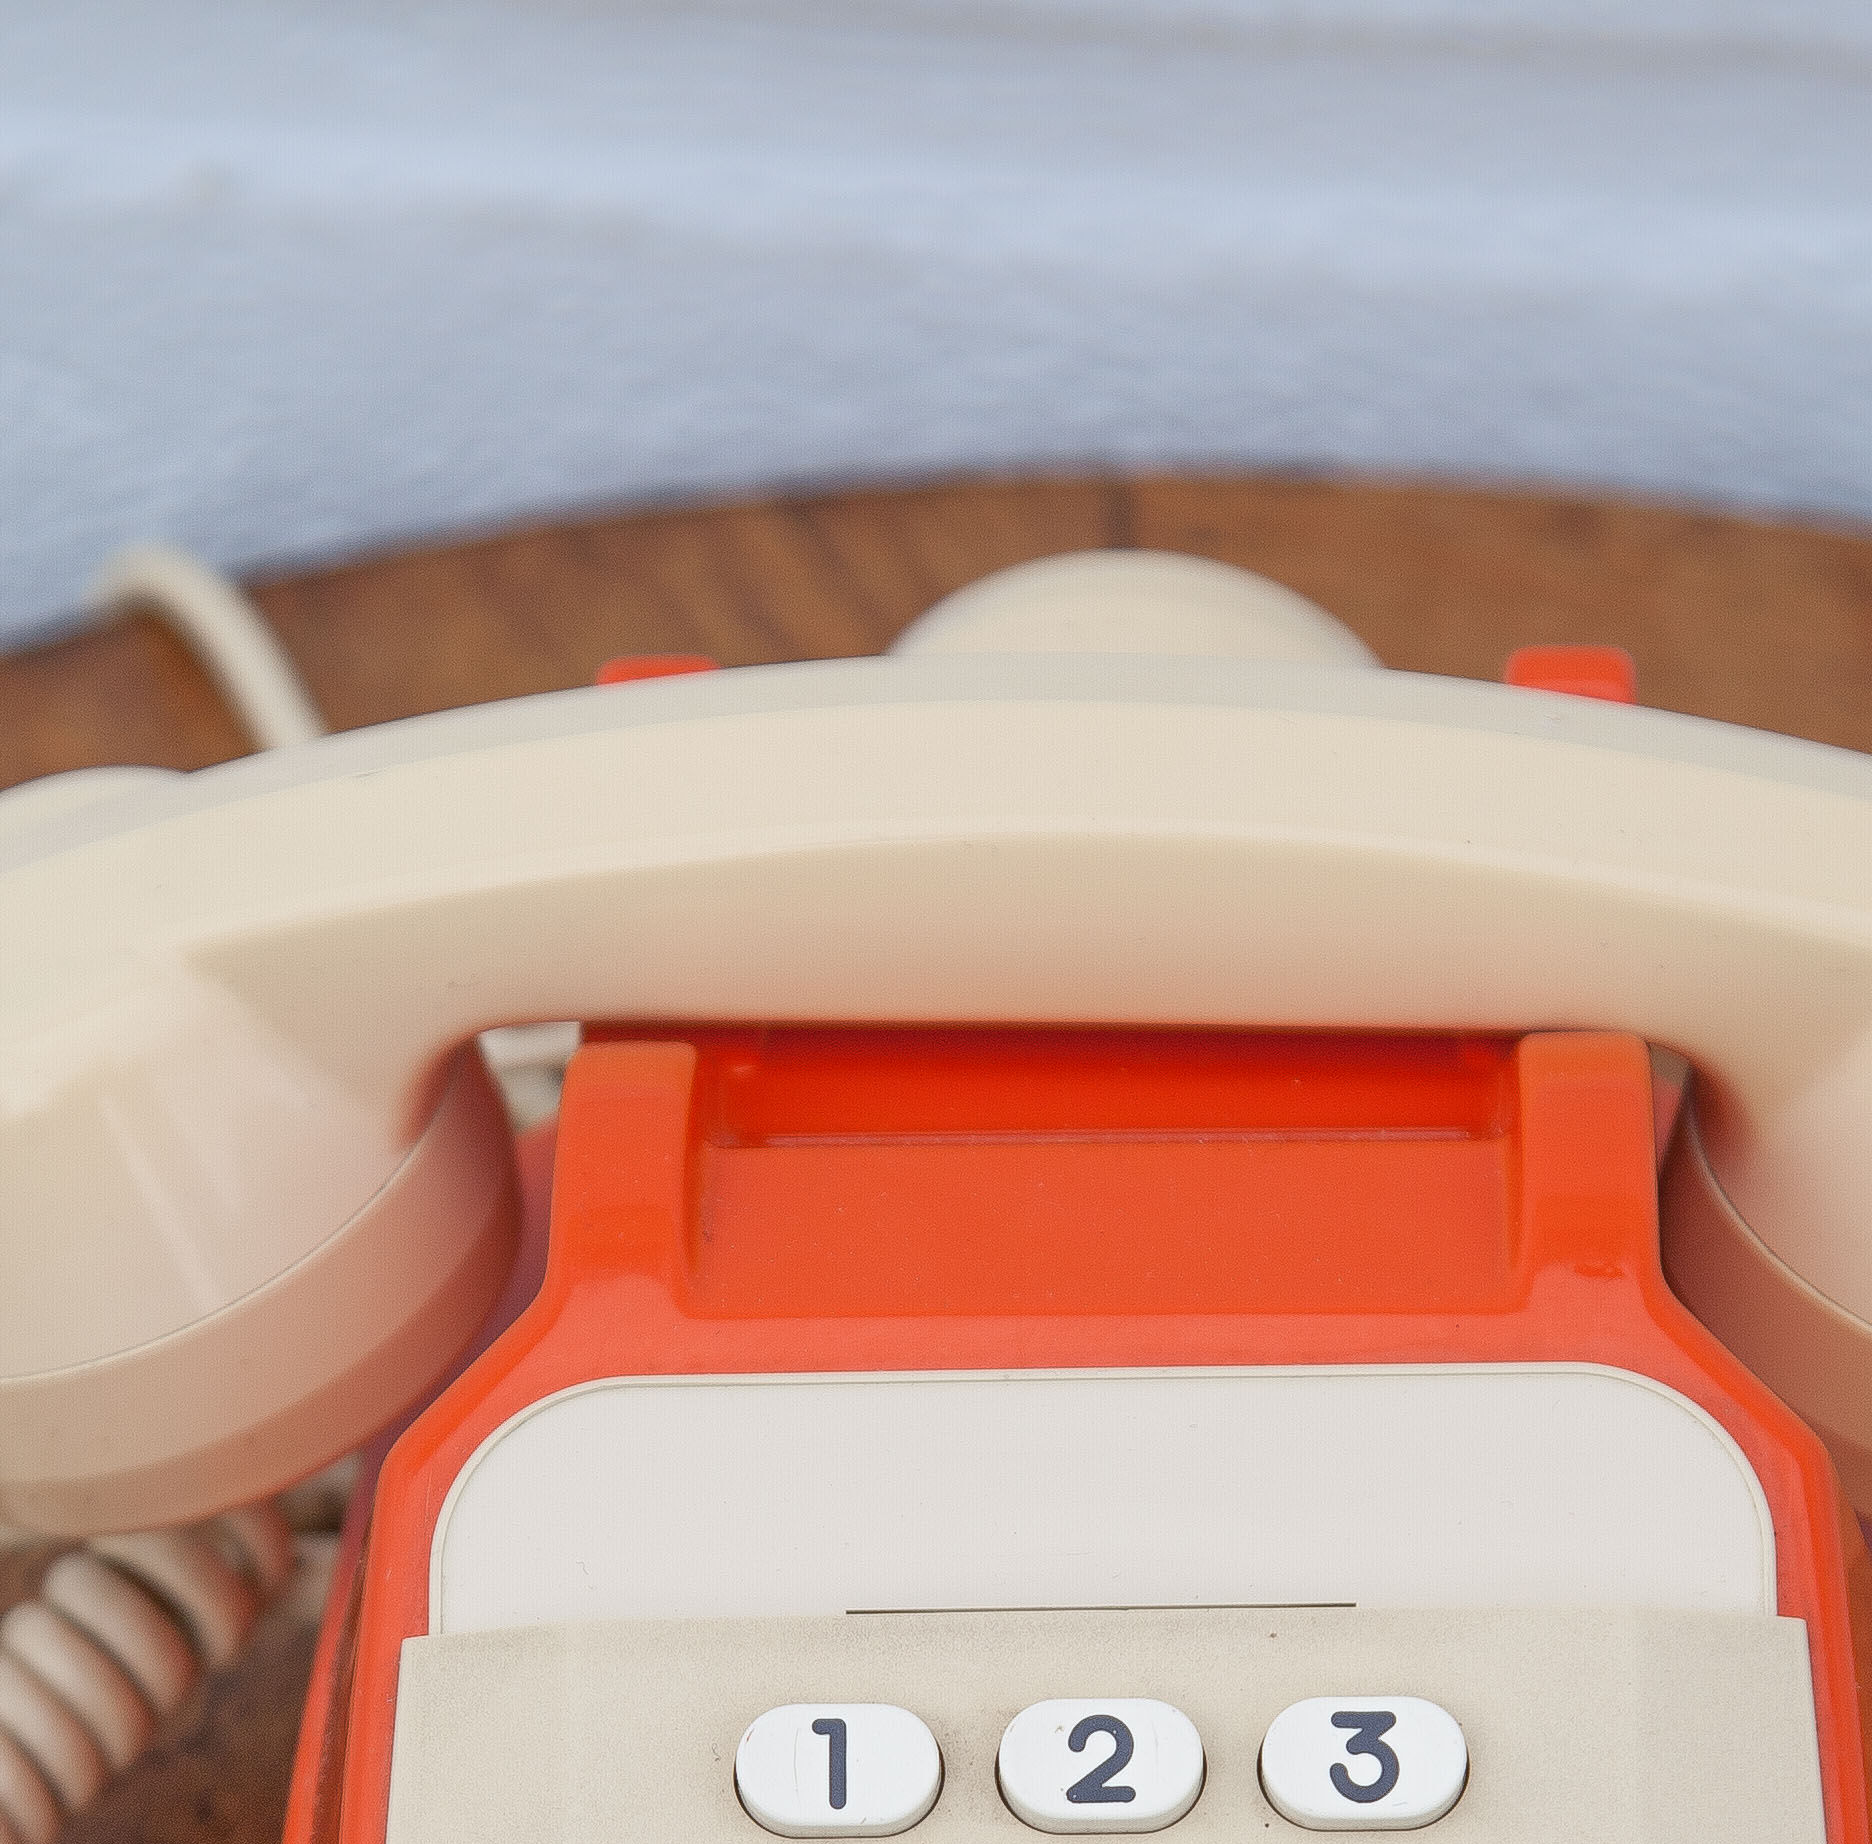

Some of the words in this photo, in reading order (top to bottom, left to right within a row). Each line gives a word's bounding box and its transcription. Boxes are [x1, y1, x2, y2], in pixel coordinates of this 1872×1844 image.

[811, 1718, 847, 1810] 1
[1065, 1714, 1137, 1804] 2
[1329, 1711, 1400, 1804] 3
